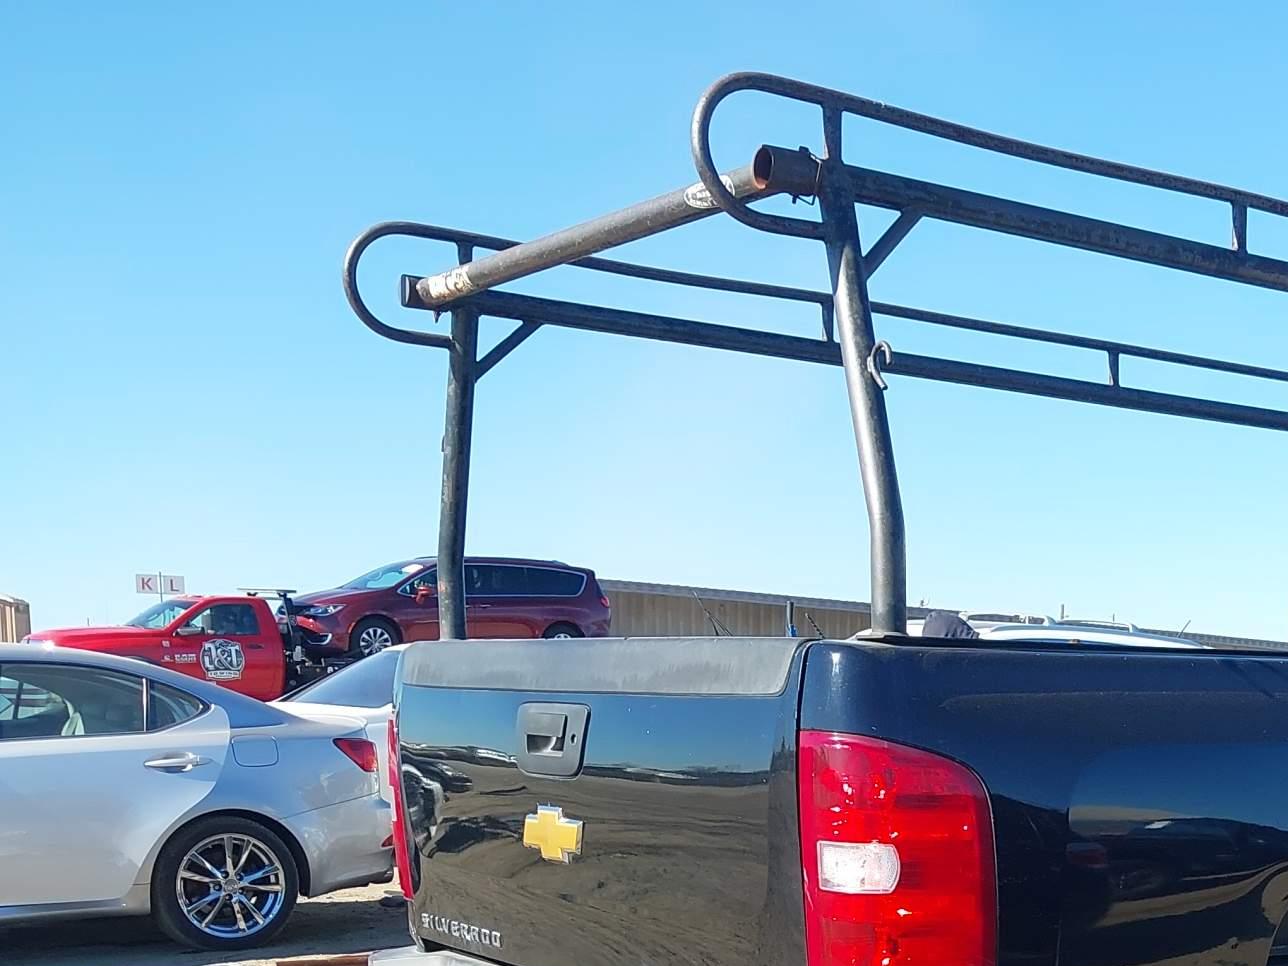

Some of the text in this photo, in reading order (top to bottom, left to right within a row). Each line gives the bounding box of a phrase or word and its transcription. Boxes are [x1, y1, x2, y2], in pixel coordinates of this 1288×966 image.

[141, 577, 153, 591] K
[169, 578, 180, 592] L
[421, 912, 502, 949] SILVERADO
